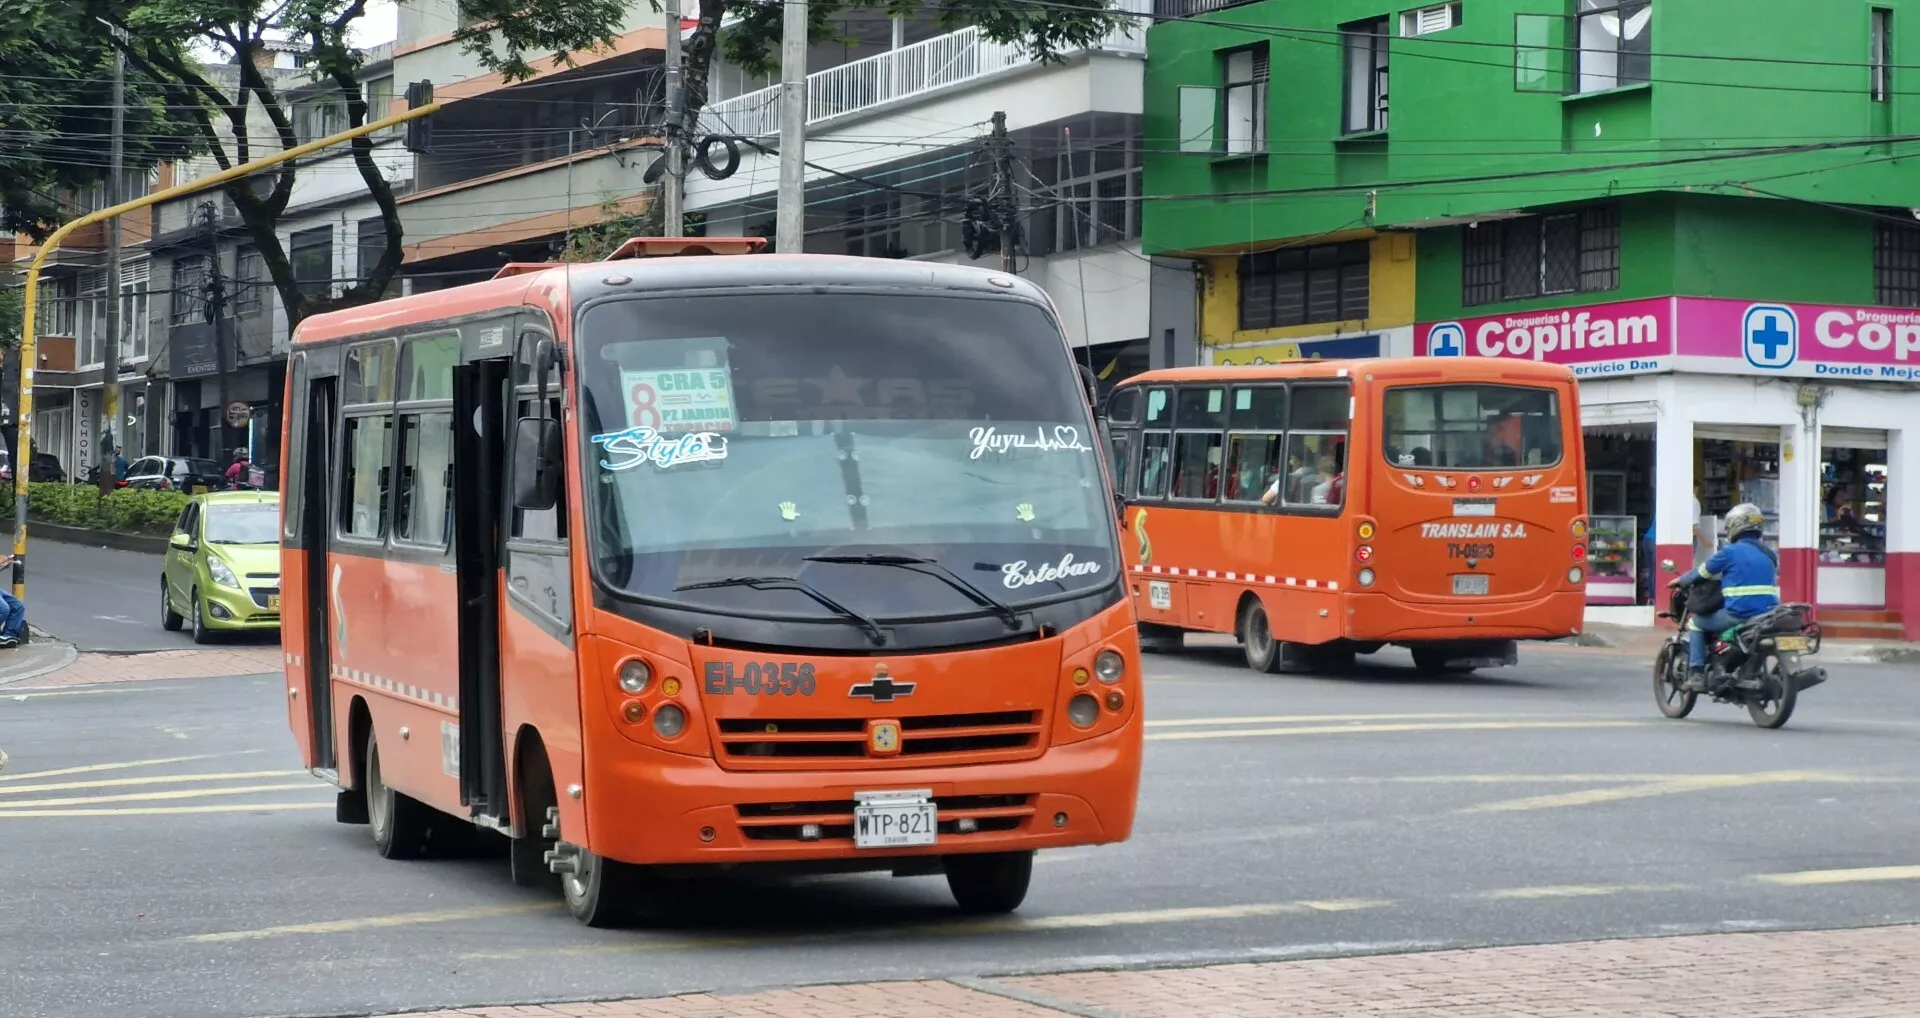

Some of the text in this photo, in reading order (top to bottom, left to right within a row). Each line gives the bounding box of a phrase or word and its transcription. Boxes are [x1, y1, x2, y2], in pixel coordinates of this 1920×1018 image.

[1476, 311, 1658, 361] Copifam
[1815, 310, 1920, 360] Cop
[187, 363, 217, 374] EVENTOS
[657, 371, 725, 391] CRA 5
[1630, 359, 1658, 370] Dan
[1816, 364, 1873, 376] Donde
[631, 383, 661, 432] 8
[662, 407, 730, 421] PZ JARDIN
[80, 390, 89, 477] COLCHONES
[591, 426, 722, 470] Style
[969, 427, 1026, 459] Yuyu
[1421, 523, 1527, 538] TRANSLAIN S.A.
[1001, 553, 1101, 588] Esteban
[704, 661, 816, 696] EI-0356
